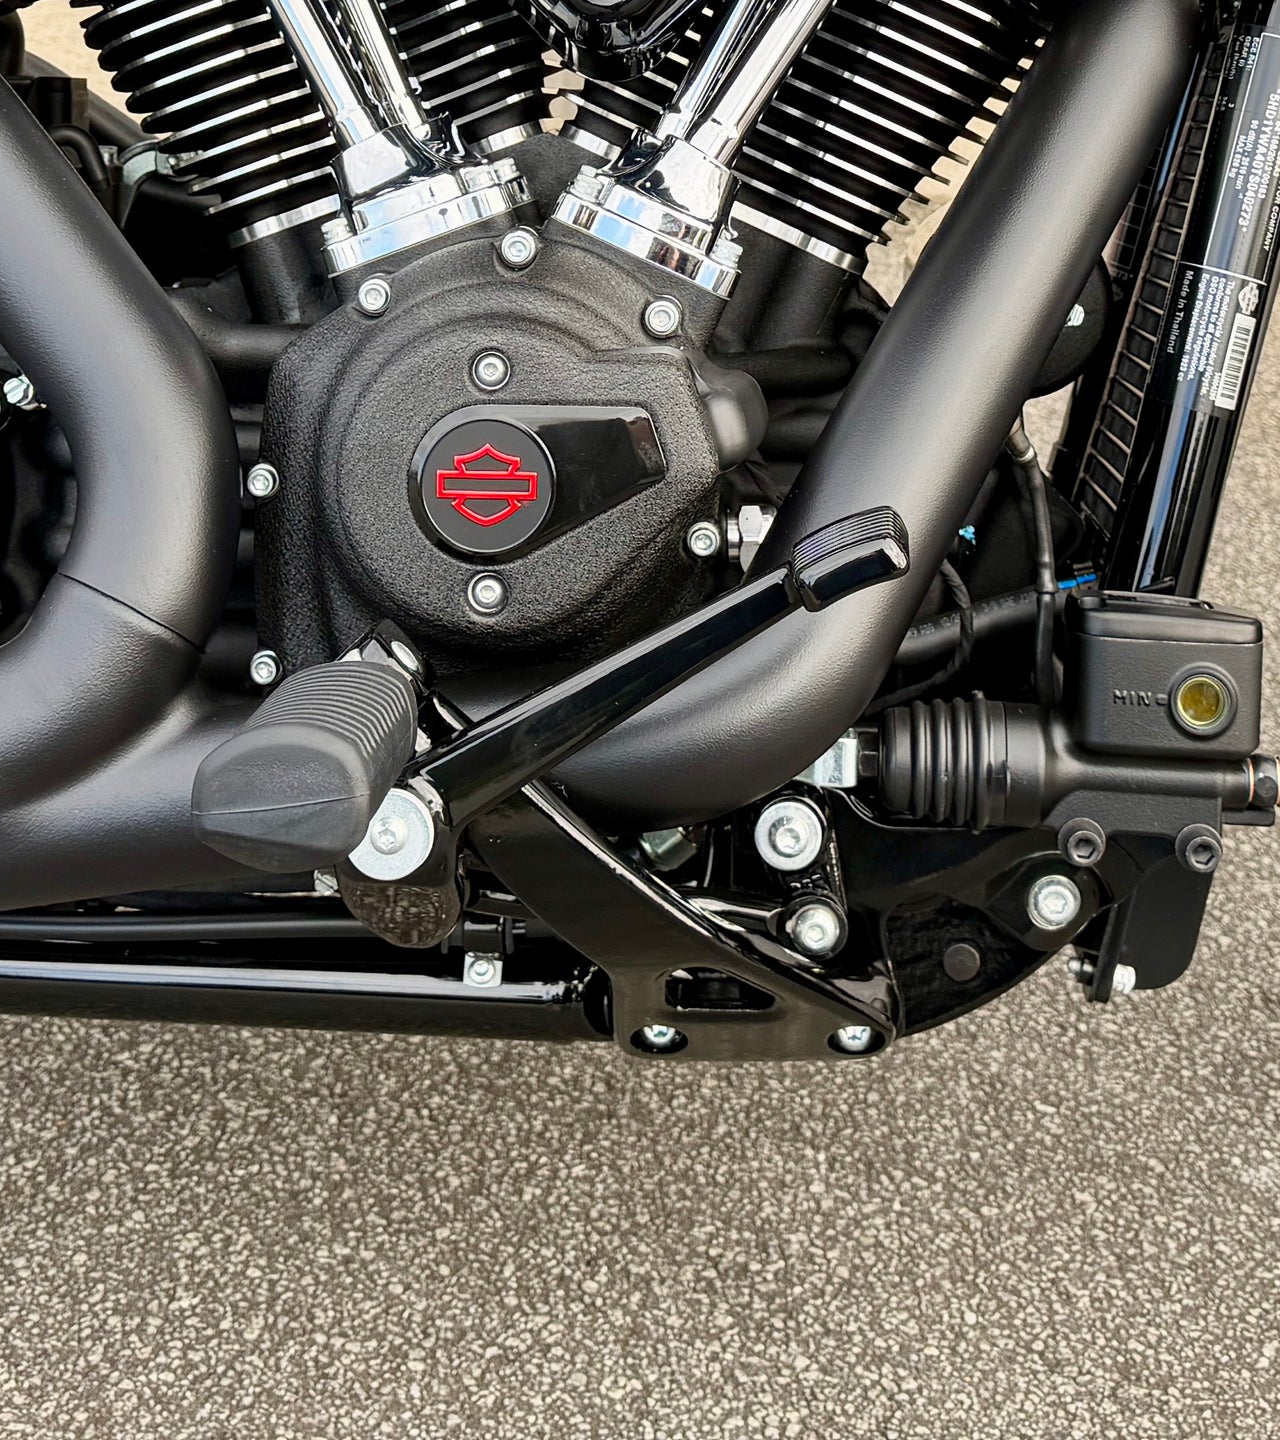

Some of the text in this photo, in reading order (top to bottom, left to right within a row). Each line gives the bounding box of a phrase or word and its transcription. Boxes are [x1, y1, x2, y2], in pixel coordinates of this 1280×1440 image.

[1240, 34, 1251, 57] GEAR
[1261, 205, 1279, 251] COMPANY
[1179, 269, 1193, 298] Made
[1195, 272, 1210, 300] Engine
[1211, 277, 1226, 313] conforms
[1165, 309, 1184, 353] Thailand
[1196, 293, 1214, 336] motorcycle
[1212, 294, 1231, 337] motorcycle
[1195, 332, 1212, 372] applicable
[1113, 689, 1151, 707] MIN
